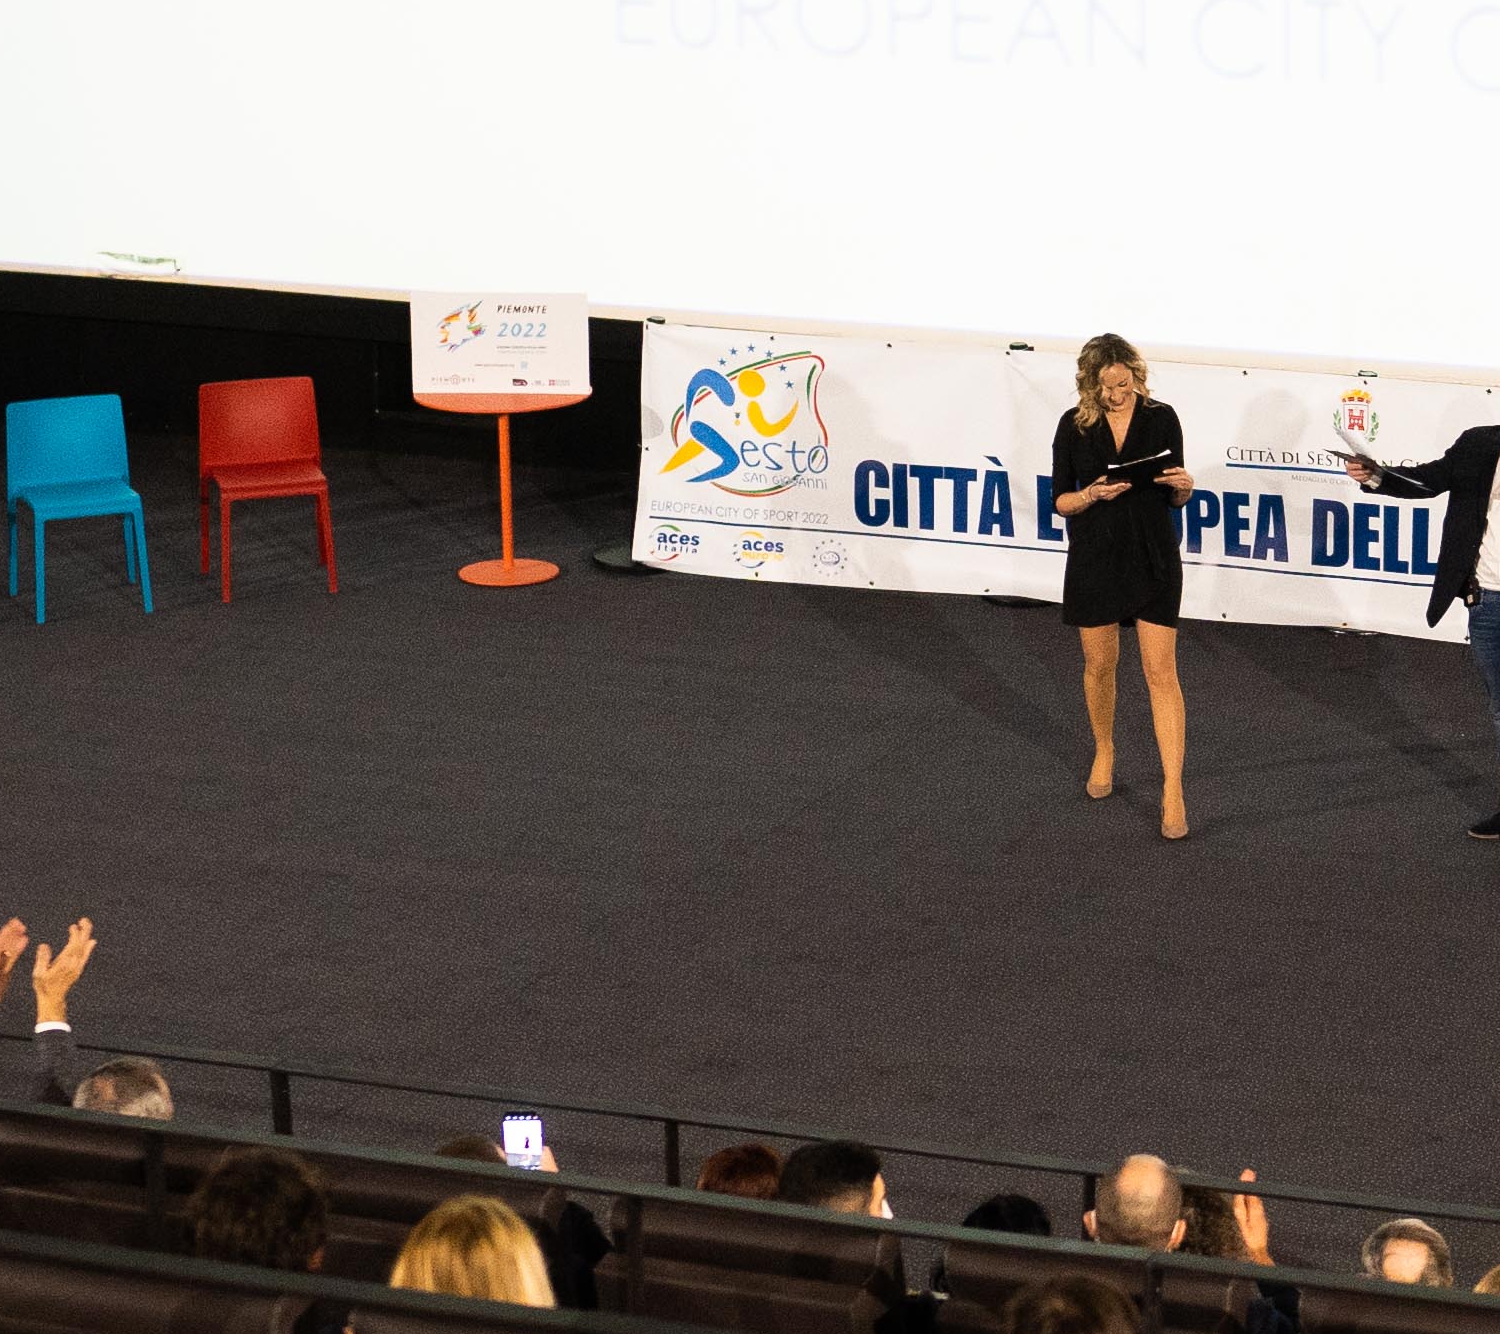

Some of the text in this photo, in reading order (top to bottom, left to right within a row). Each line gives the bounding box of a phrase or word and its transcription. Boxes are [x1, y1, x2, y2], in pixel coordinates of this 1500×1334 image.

[497, 305, 547, 314] PIEMONTE
[497, 322, 547, 338] 2022
[651, 500, 829, 525] EUROPEAN CITY OF SPORT 2022
[853, 455, 1015, 538] CITTÀ
[1310, 497, 1439, 577] DELL
[657, 532, 700, 546] aces
[742, 539, 784, 553] aces
